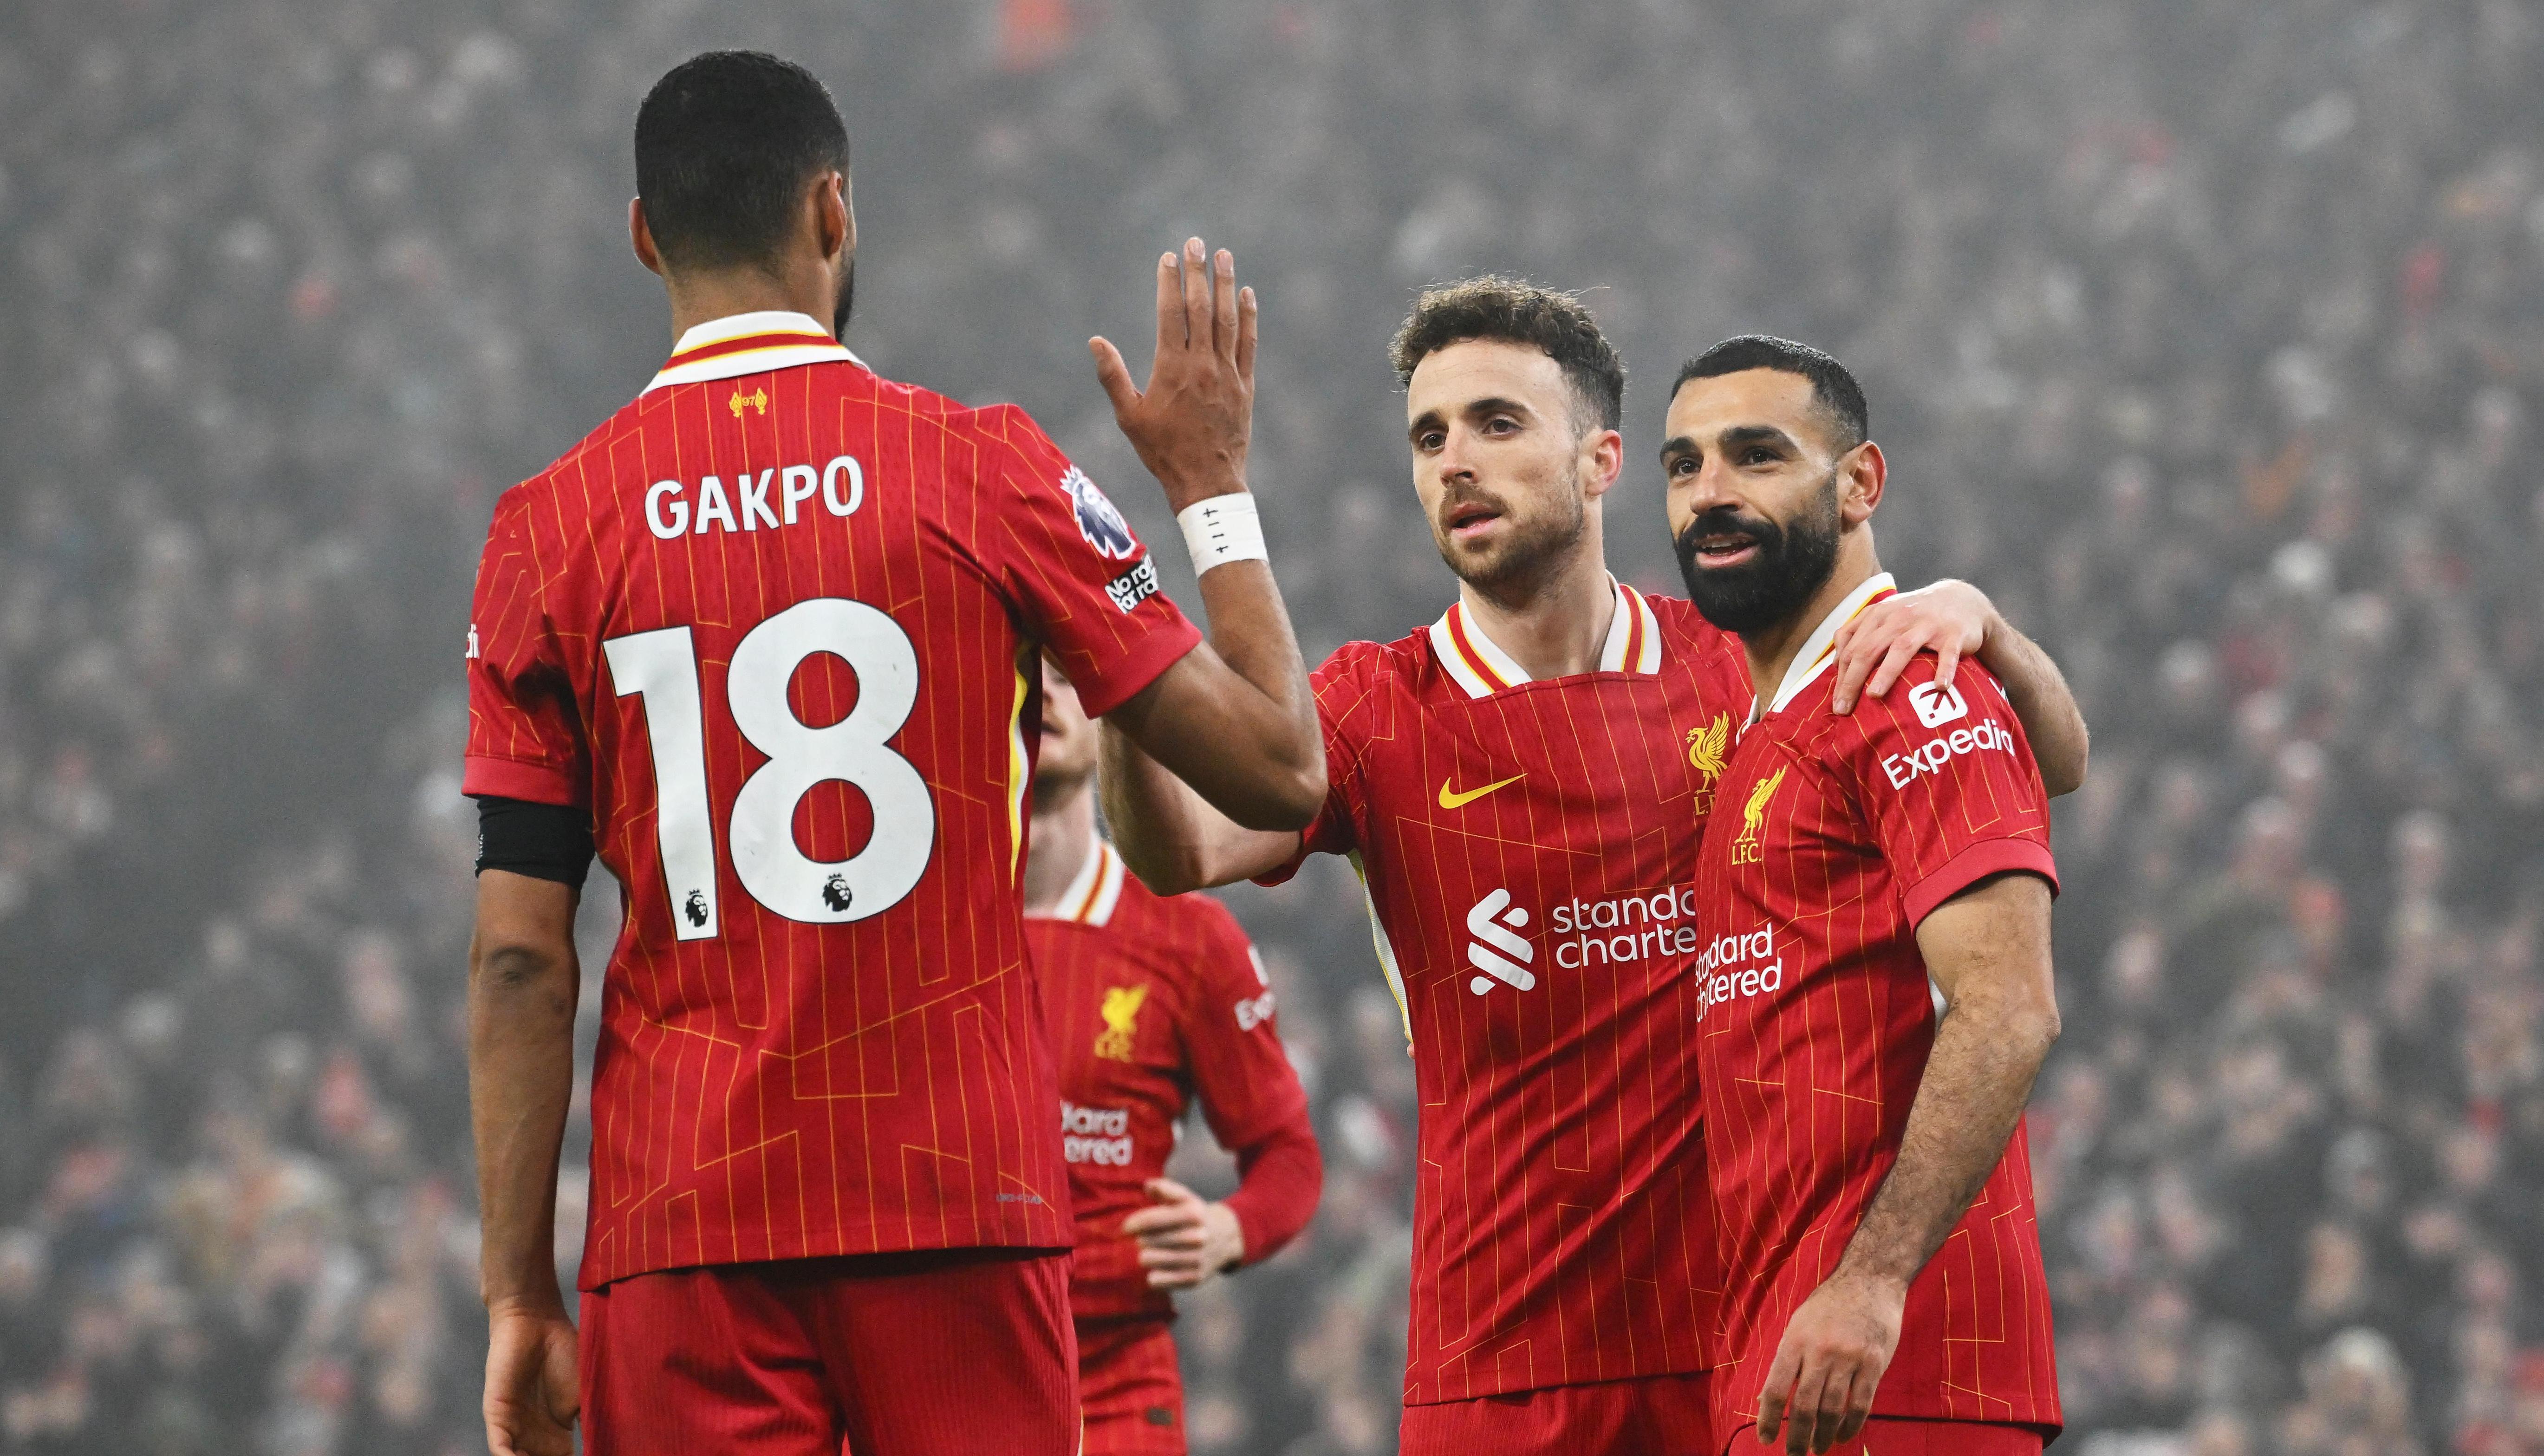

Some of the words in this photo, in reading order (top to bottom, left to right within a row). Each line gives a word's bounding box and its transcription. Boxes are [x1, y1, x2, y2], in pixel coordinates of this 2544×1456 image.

[742, 396, 755, 407] 97
[644, 455, 864, 540] GAKPO
[1105, 576, 1132, 603] No
[602, 597, 936, 942] 18
[1881, 718, 2016, 790] Expedia
[1731, 843, 1762, 865] L.F.C.
